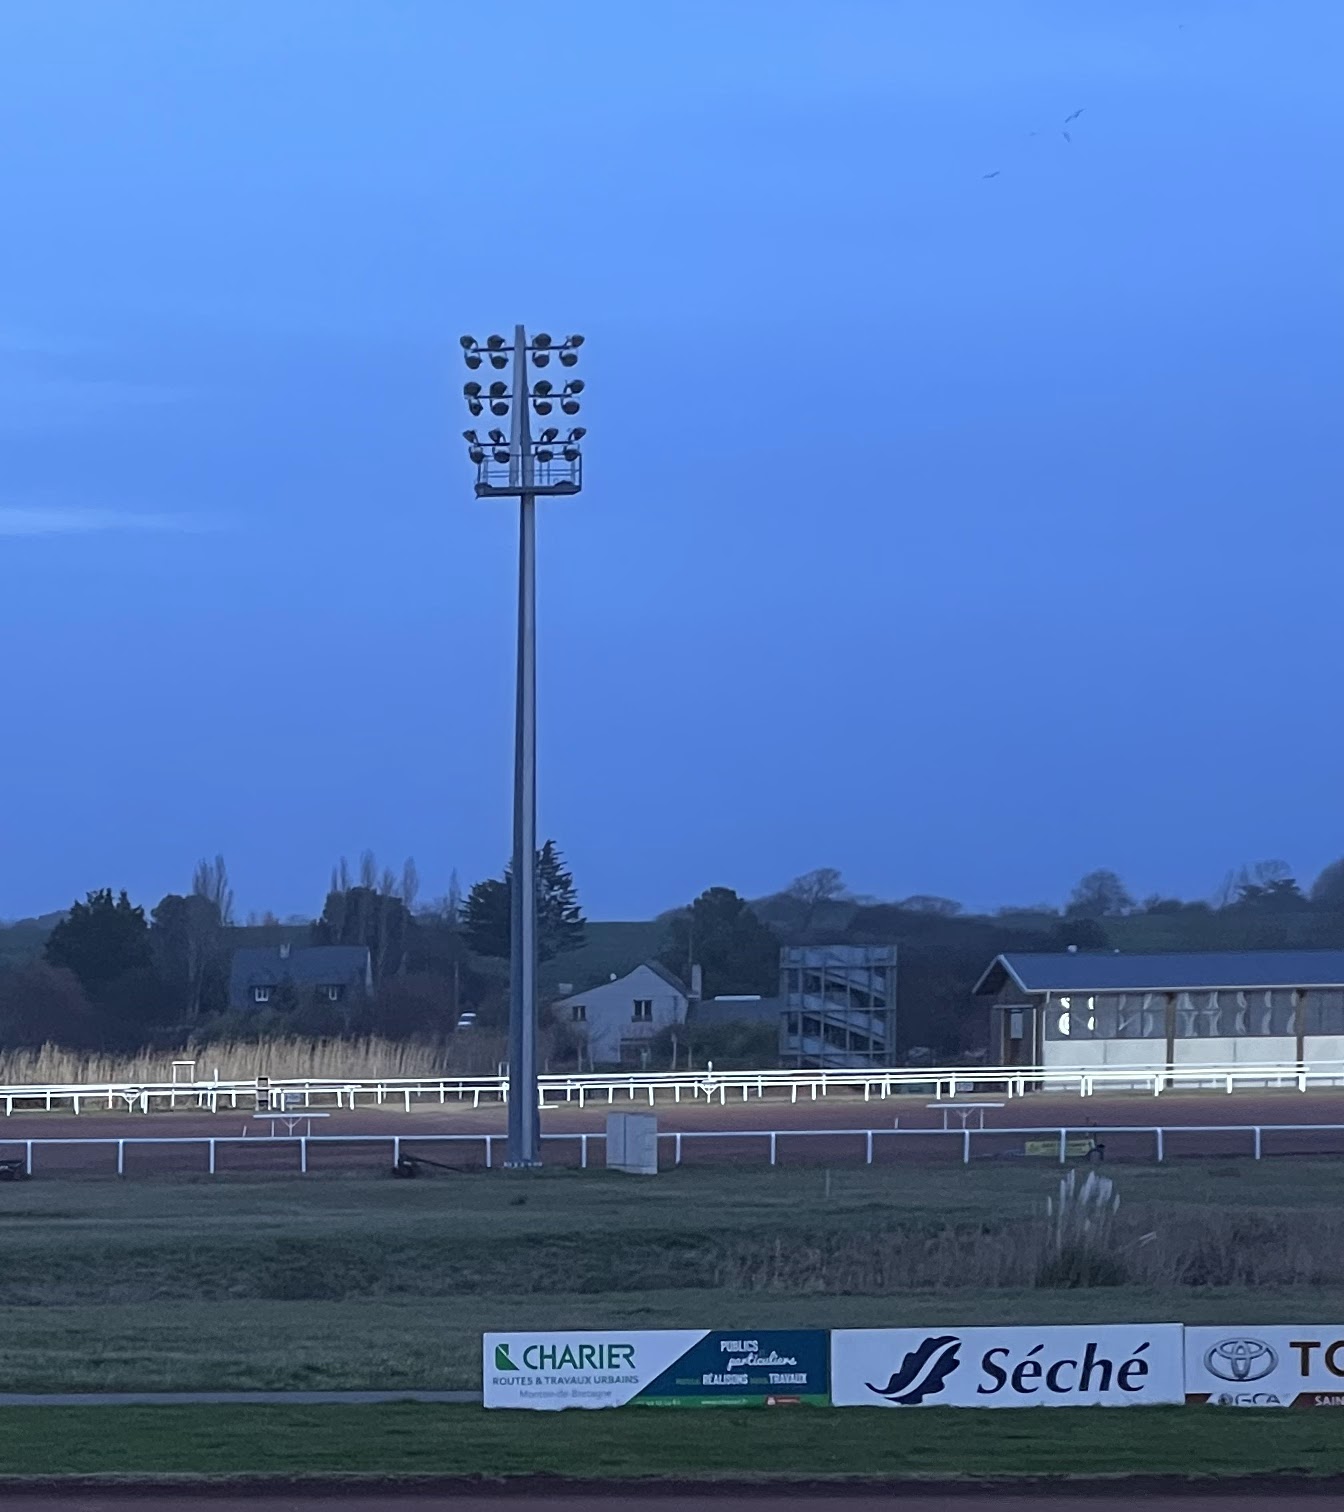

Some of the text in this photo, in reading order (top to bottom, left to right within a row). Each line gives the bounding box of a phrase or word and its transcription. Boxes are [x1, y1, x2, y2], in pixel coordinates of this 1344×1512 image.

[720, 1340, 758, 1352] PUBLICS
[523, 1344, 636, 1370] CHARIER
[727, 1351, 797, 1371] particuliers
[977, 1342, 1150, 1394] Séché
[493, 1375, 639, 1386] ROUTES & TRAVAUX URBAINS
[702, 1373, 748, 1385] RÉALISONS
[769, 1373, 807, 1384] TRAVAUX
